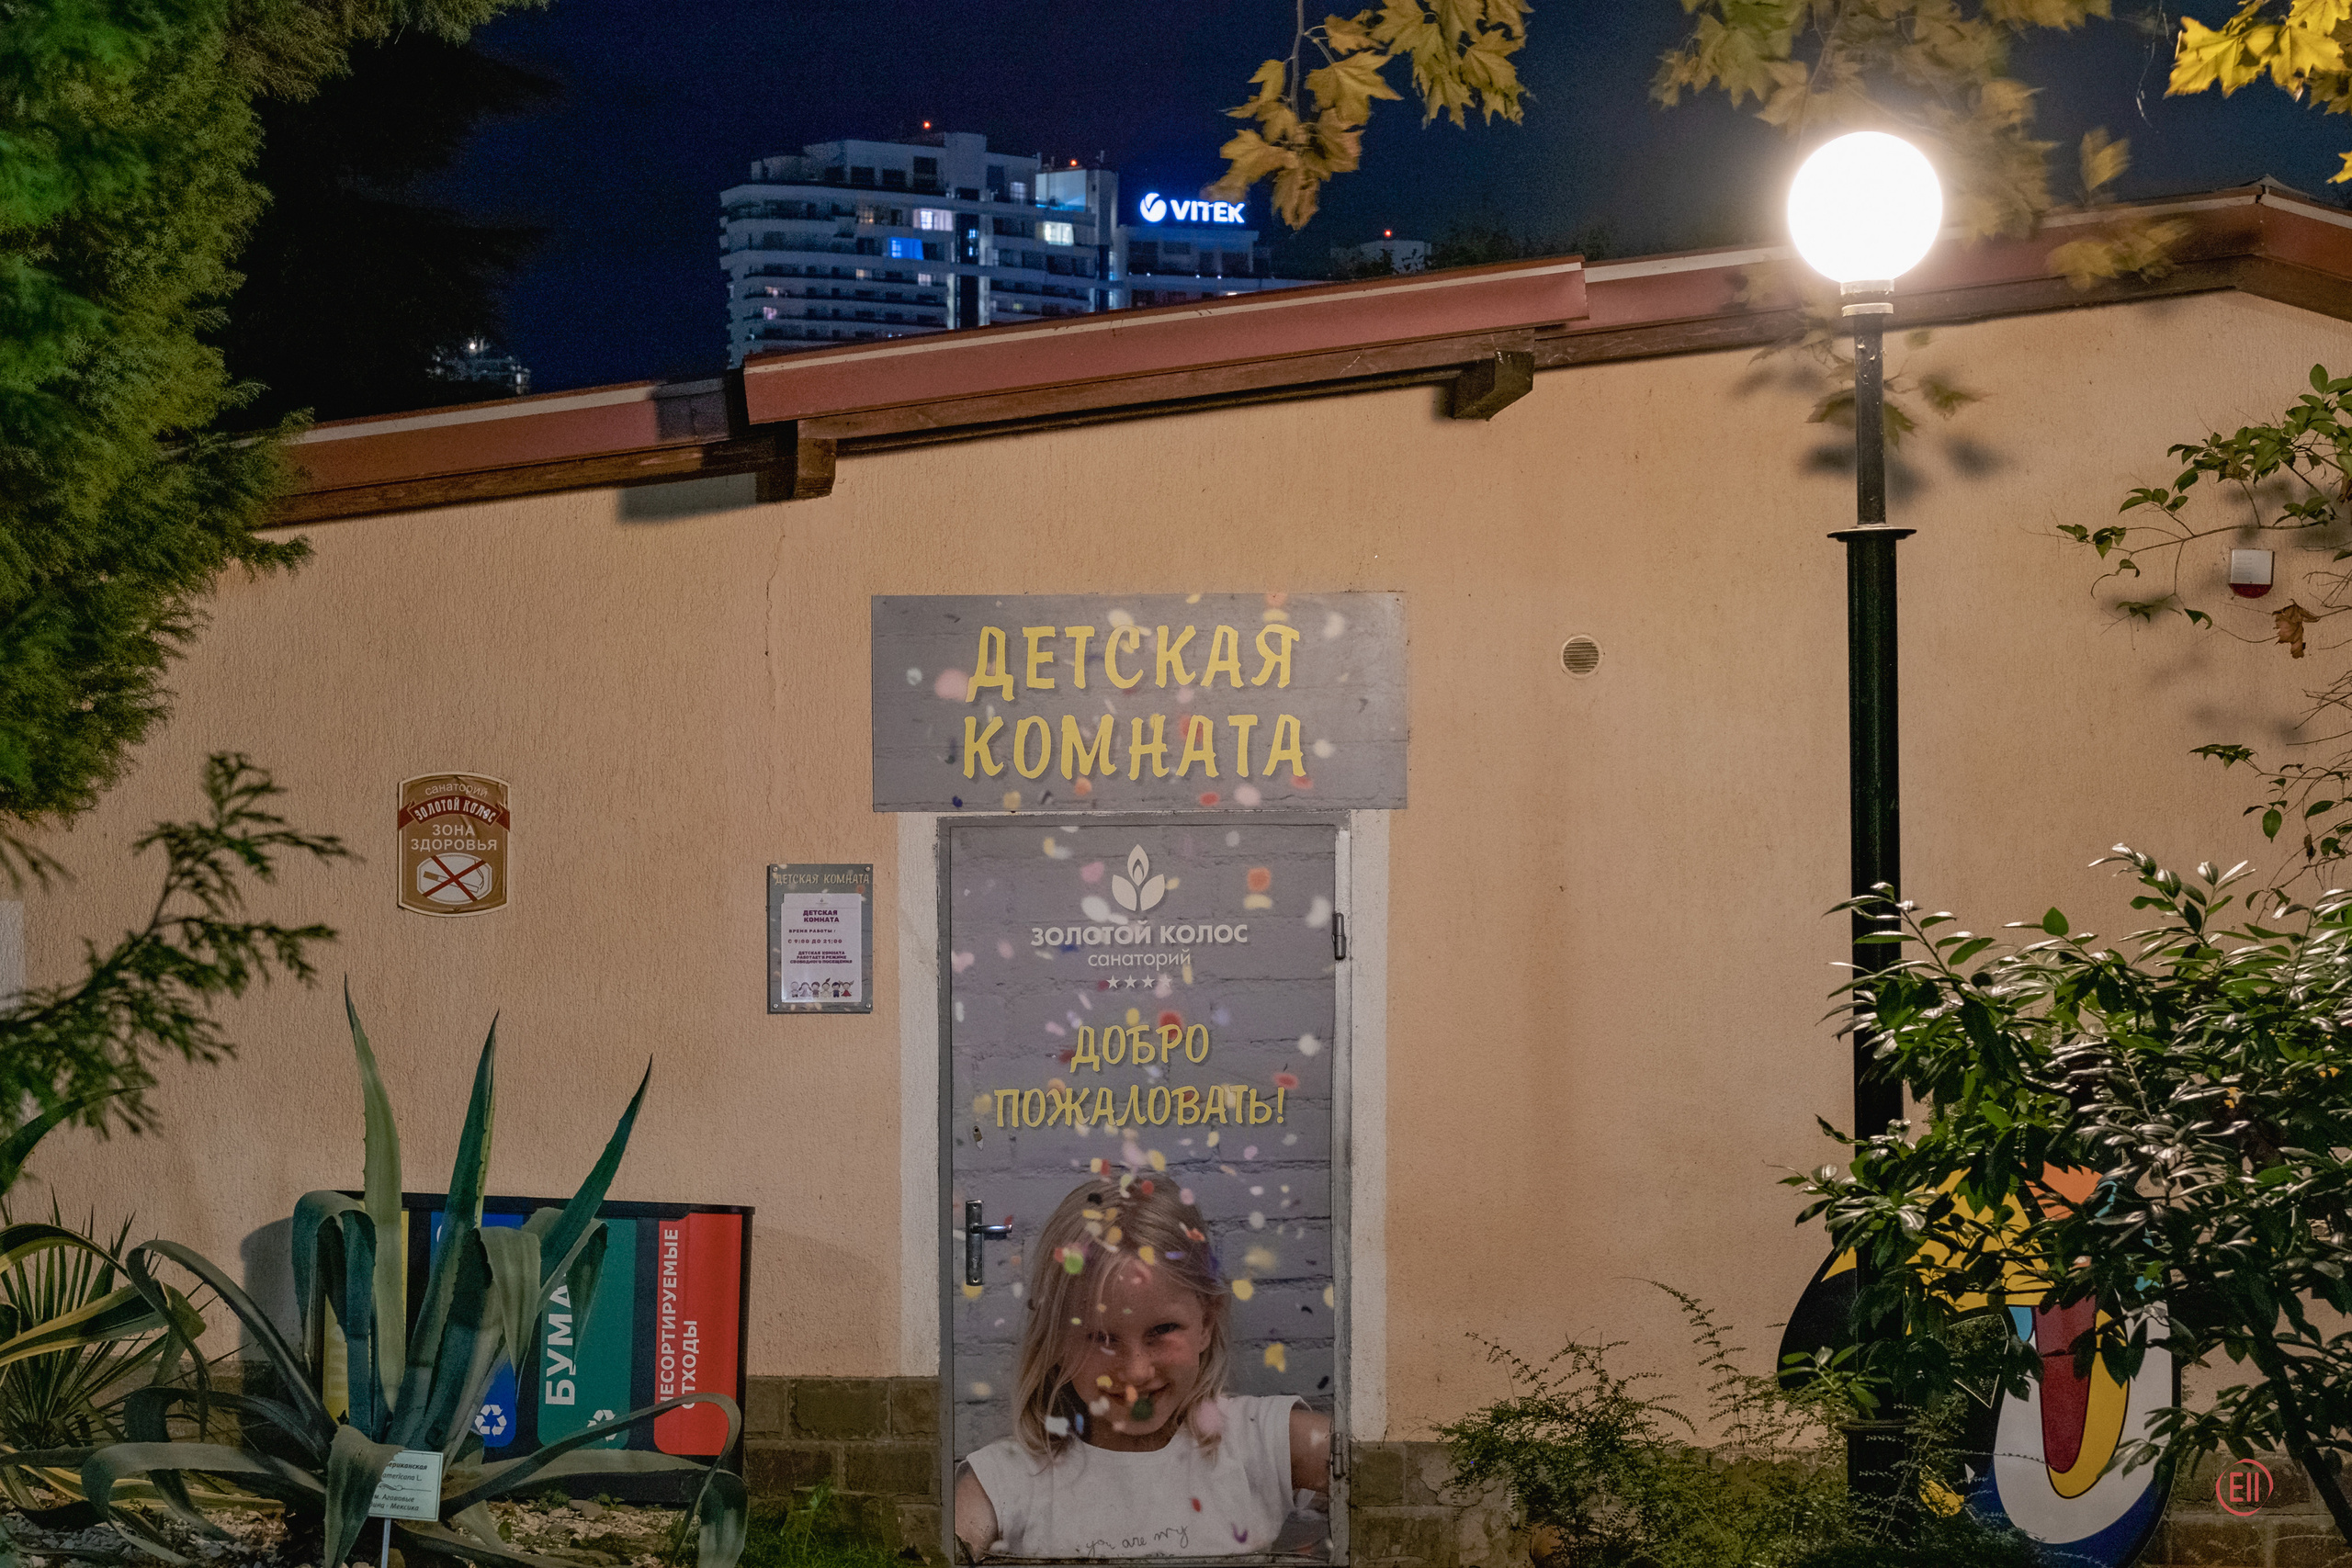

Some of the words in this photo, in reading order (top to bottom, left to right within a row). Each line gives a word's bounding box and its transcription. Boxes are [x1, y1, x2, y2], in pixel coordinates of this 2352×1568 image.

[1170, 199, 1246, 223] VITEK
[964, 623, 1301, 703] ДЕТСКАЯ
[963, 714, 1307, 781] КОМНАТА
[424, 783, 489, 798] санаторий
[413, 796, 460, 821] ЗОЛОТОЙ
[462, 799, 497, 823] КОЛОС
[432, 824, 475, 836] ЗОНА
[410, 838, 498, 852] ЗДОРОВЬЯ
[775, 873, 820, 886] ДЕТСКАЯ
[823, 873, 870, 886] КОМНАТА
[1030, 919, 1152, 946] ЗОЛОТОЙ
[1159, 923, 1249, 944] КОЛОС
[1087, 948, 1192, 971] санаторий
[1069, 1022, 1210, 1074] ДОБРО
[993, 1084, 1286, 1128] ПОЖАЛОВАТЬ!
[545, 1273, 577, 1405] БУМА
[387, 1461, 428, 1471] ериканская
[1122, 1537, 1148, 1549] are
